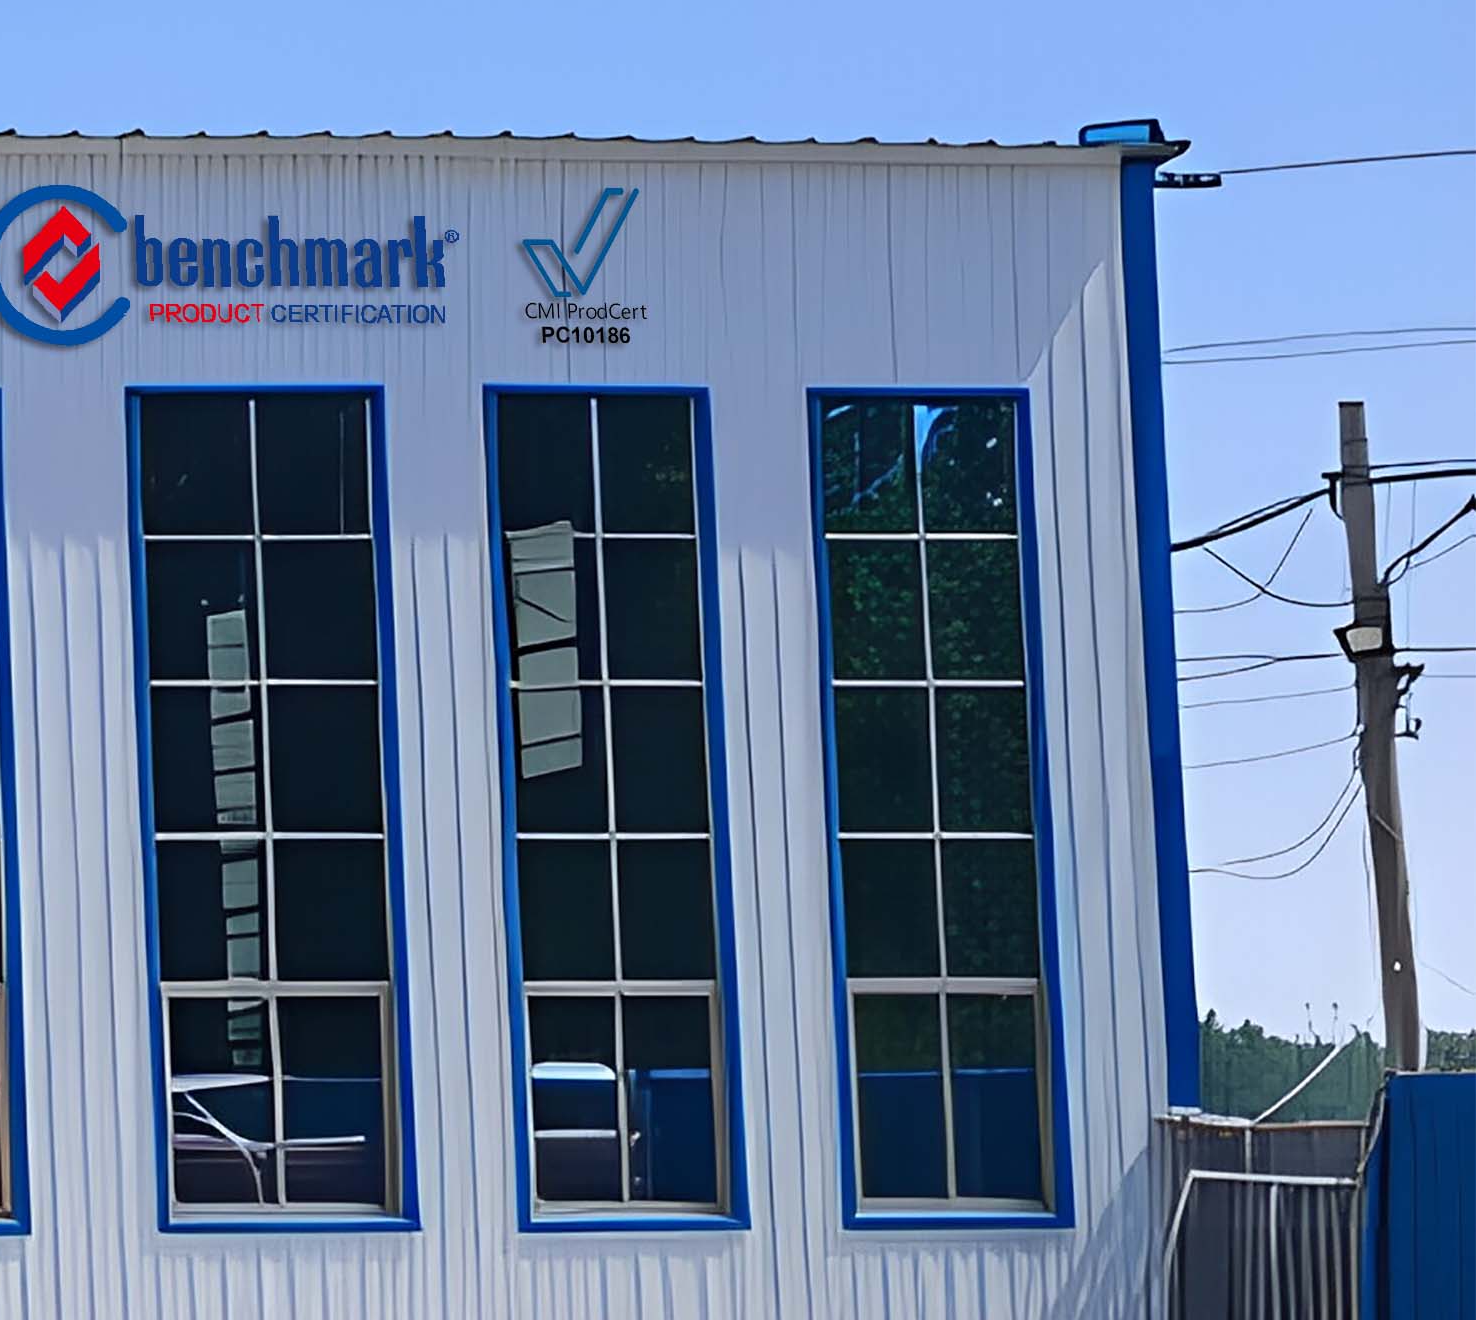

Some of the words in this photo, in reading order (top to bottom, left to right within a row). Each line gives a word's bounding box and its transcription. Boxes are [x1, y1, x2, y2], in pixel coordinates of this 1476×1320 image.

[149, 303, 264, 324] PRODUCT
[270, 303, 446, 325] CERTIFICATION
[524, 302, 561, 320] CMI
[567, 302, 648, 321] ProdCert
[541, 326, 631, 345] PC10186
